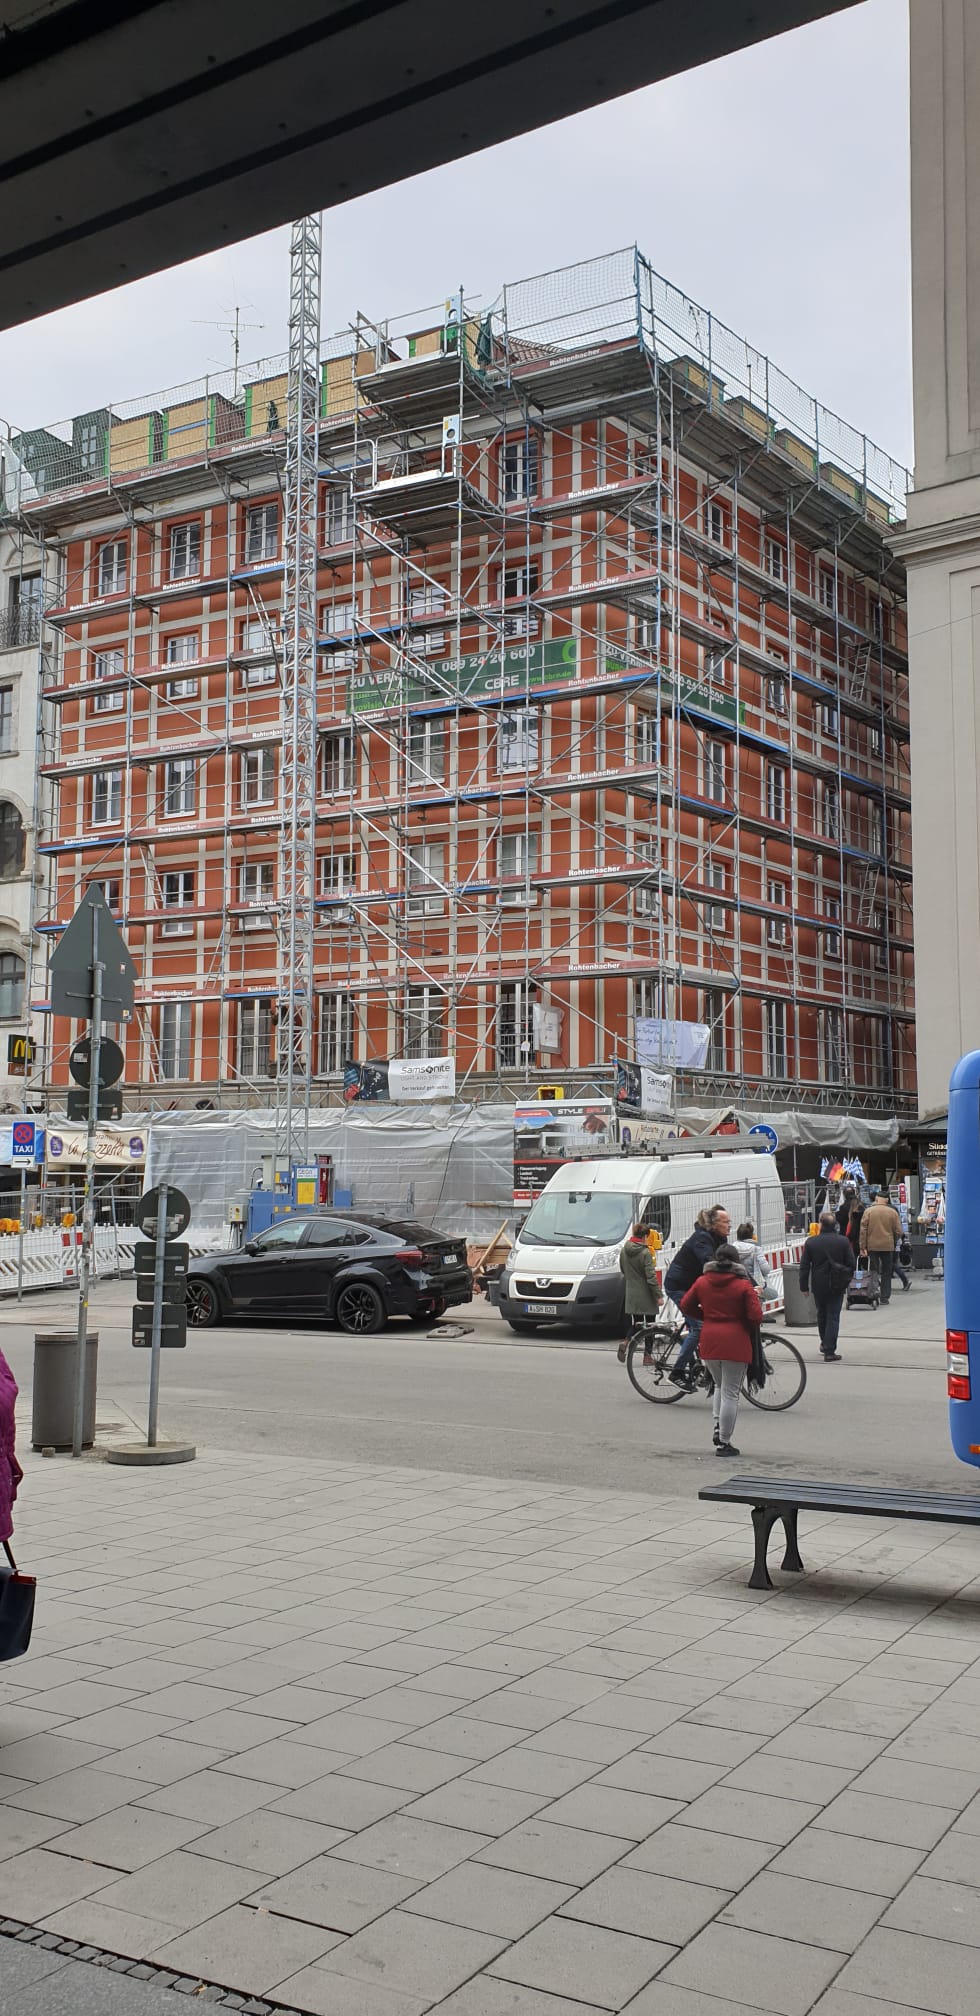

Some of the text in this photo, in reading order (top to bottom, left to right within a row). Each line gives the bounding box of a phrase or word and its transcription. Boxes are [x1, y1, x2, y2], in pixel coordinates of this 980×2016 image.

[568, 483, 619, 499] Rohtenbacher
[568, 578, 619, 592] Rohtenbacher
[485, 674, 520, 690] CBRE
[567, 768, 619, 781] Rohtenbacher
[568, 866, 620, 877] Rohtenbacher
[568, 962, 620, 972] Rohtenbacher
[400, 1064, 450, 1075] Samsonite
[557, 1107, 583, 1115] STYLE
[14, 1145, 33, 1153] TAXI
